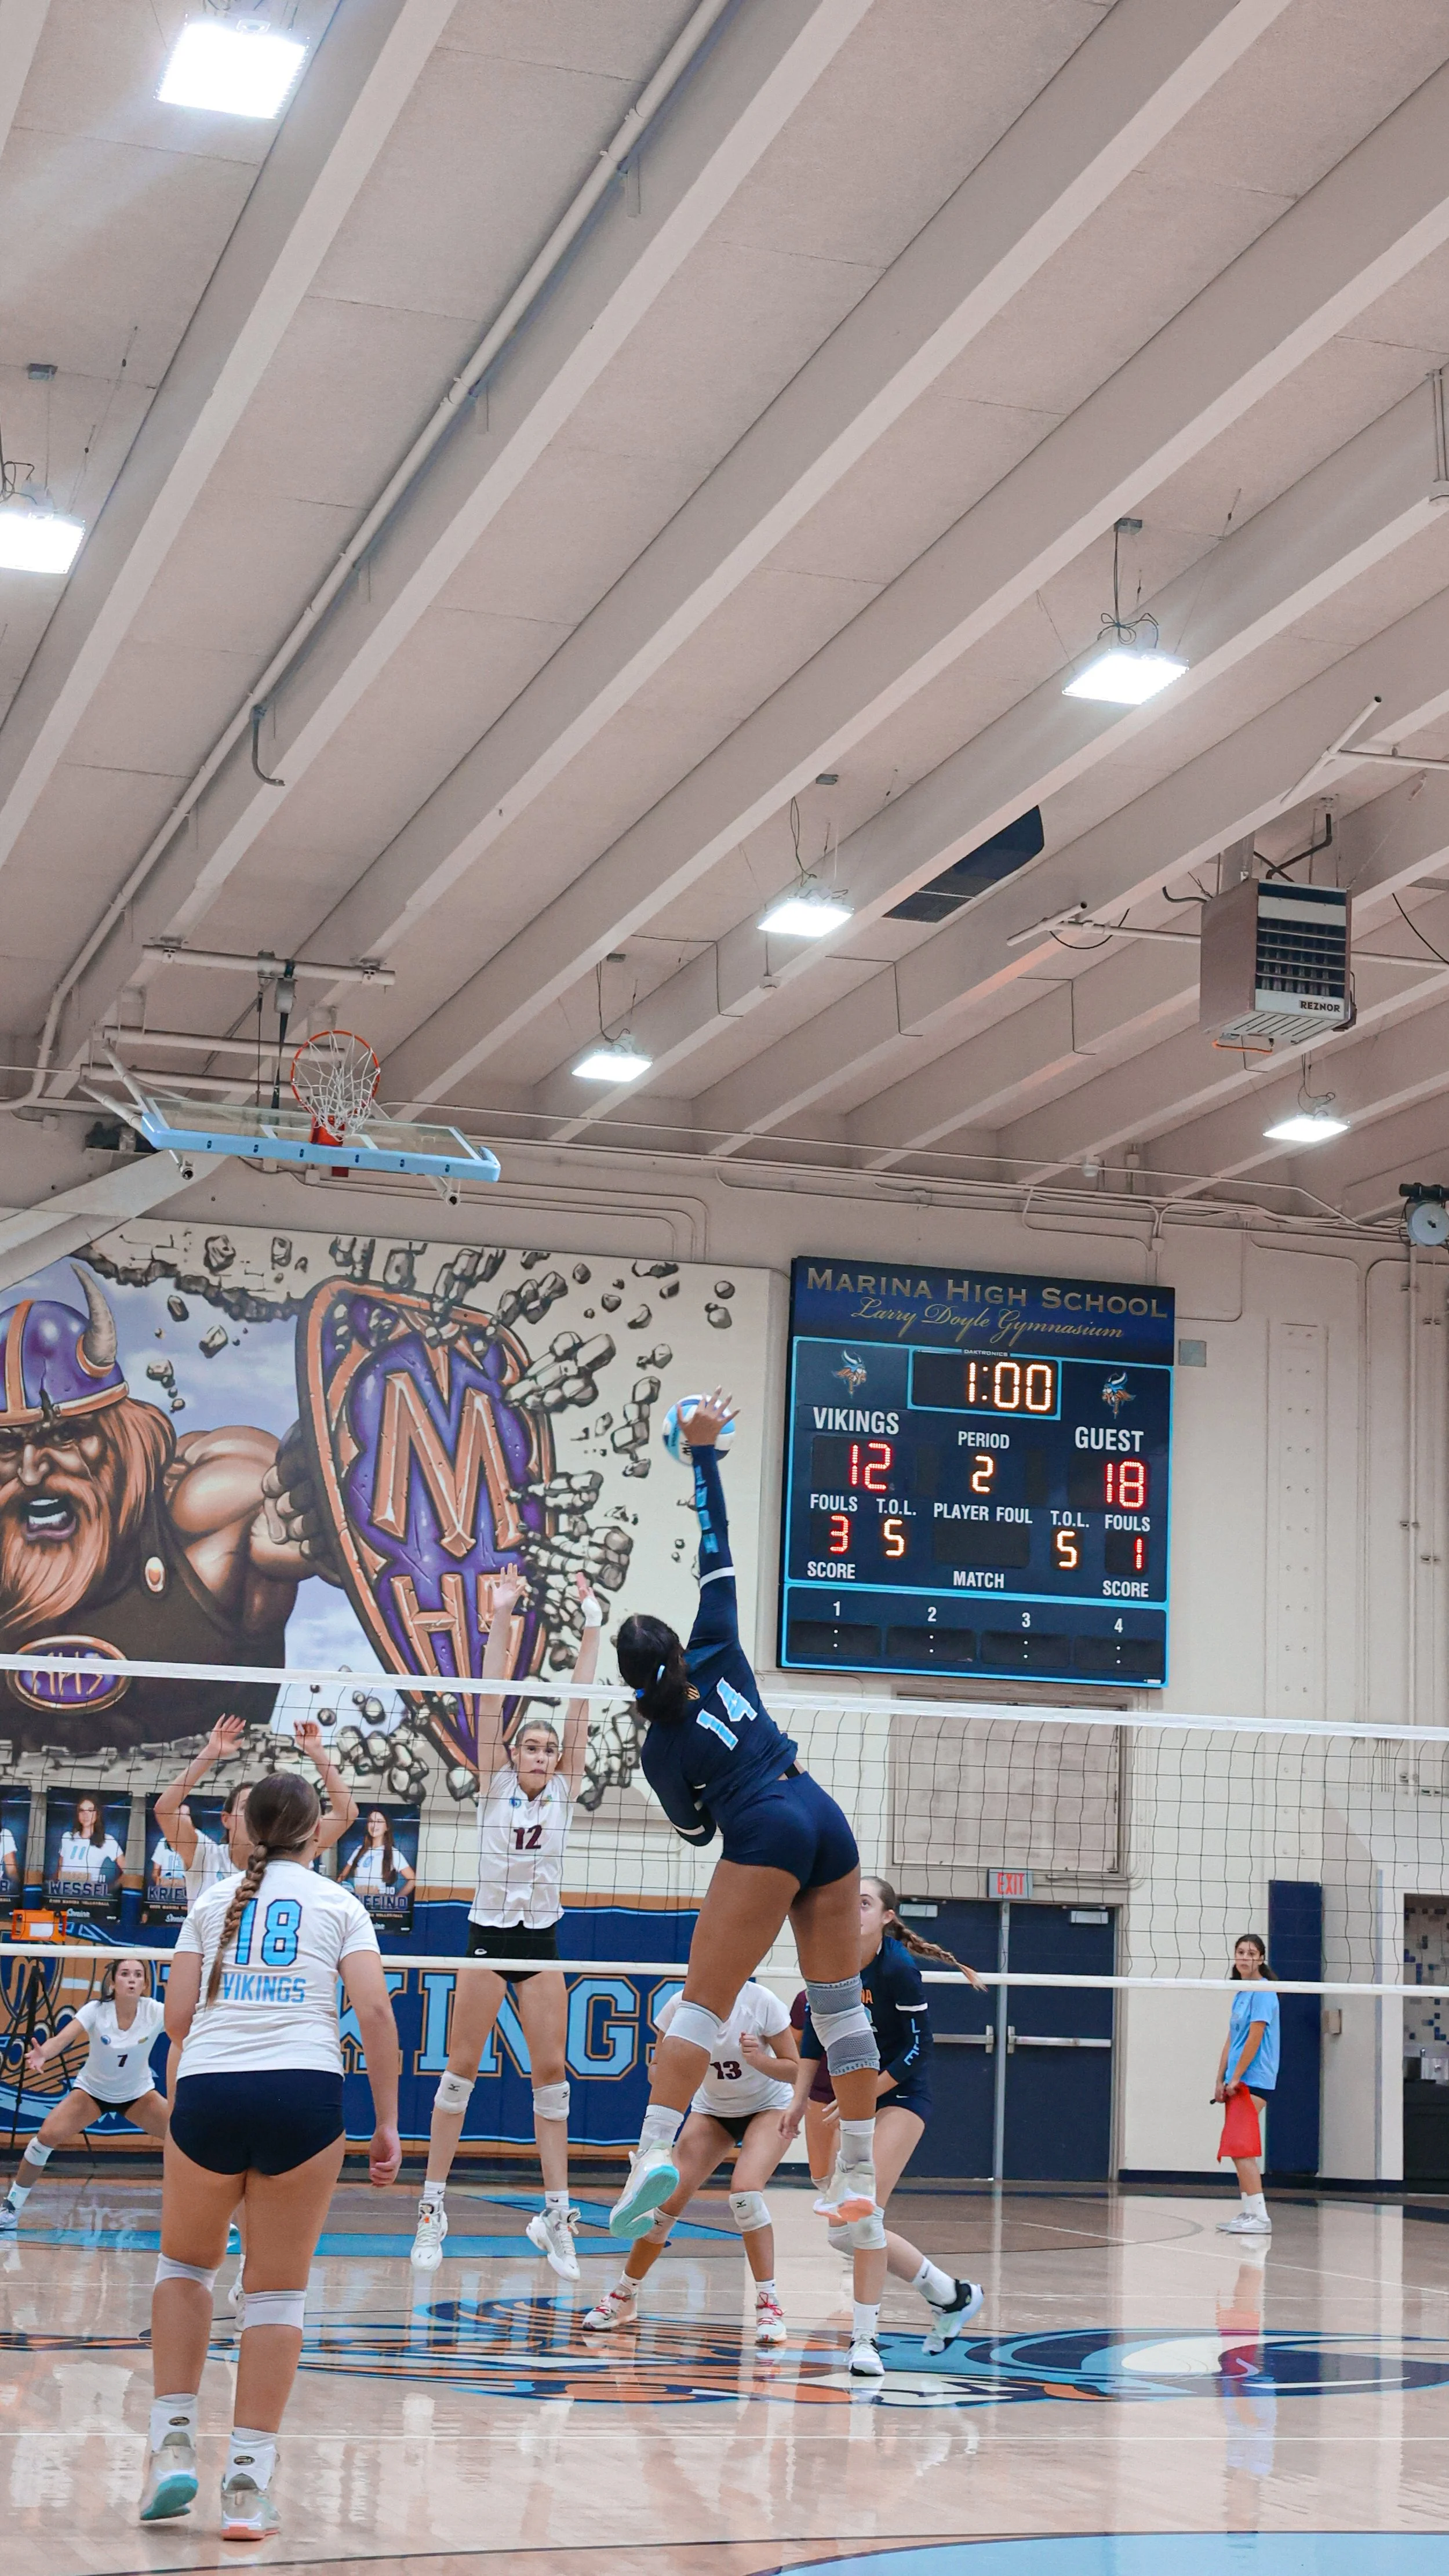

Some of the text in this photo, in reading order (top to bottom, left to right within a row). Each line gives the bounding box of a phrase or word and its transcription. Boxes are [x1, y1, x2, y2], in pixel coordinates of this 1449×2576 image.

[1300, 1000, 1341, 1013] REZNOR
[807, 1267, 1167, 1319] MARINA HIGH SCHOOL
[851, 1297, 1124, 1347] Larry Doyle Gymnasium
[964, 1349, 1009, 1357] DAKTRONICS
[969, 1361, 1052, 1411] 1:00
[813, 1407, 900, 1435] VIKINGS
[958, 1431, 1010, 1449] PERIOD
[1075, 1427, 1144, 1453] GUEST
[850, 1442, 891, 1491] 12
[971, 1455, 994, 1493] 2
[1105, 1461, 1145, 1508] 18
[810, 1494, 858, 1512] FOULS
[877, 1498, 916, 1516] T.O.L.
[933, 1503, 1033, 1525] PLAYER FOUL
[1050, 1511, 1089, 1528] T.O.L.
[1105, 1514, 1151, 1531] FOULS
[830, 1515, 849, 1553] 3
[883, 1518, 905, 1557] 5
[1056, 1530, 1077, 1569] 5
[1134, 1538, 1144, 1570] 1
[807, 1562, 855, 1580] SCORE
[953, 1570, 1005, 1589] MATCH
[1102, 1580, 1149, 1598] SCORE
[833, 1601, 840, 1616] 1
[927, 1606, 937, 1622] 2
[1022, 1612, 1031, 1628] 3
[1114, 1618, 1123, 1633] 4
[696, 1676, 758, 1751] 14
[513, 1825, 543, 1850] 12
[997, 1872, 1026, 1895] EXIT
[356, 1895, 409, 1910] FFINO
[235, 1898, 303, 1966] 18
[222, 1973, 306, 2003] VIKINGS
[116, 2054, 128, 2068] 7
[709, 2060, 742, 2080] 13
